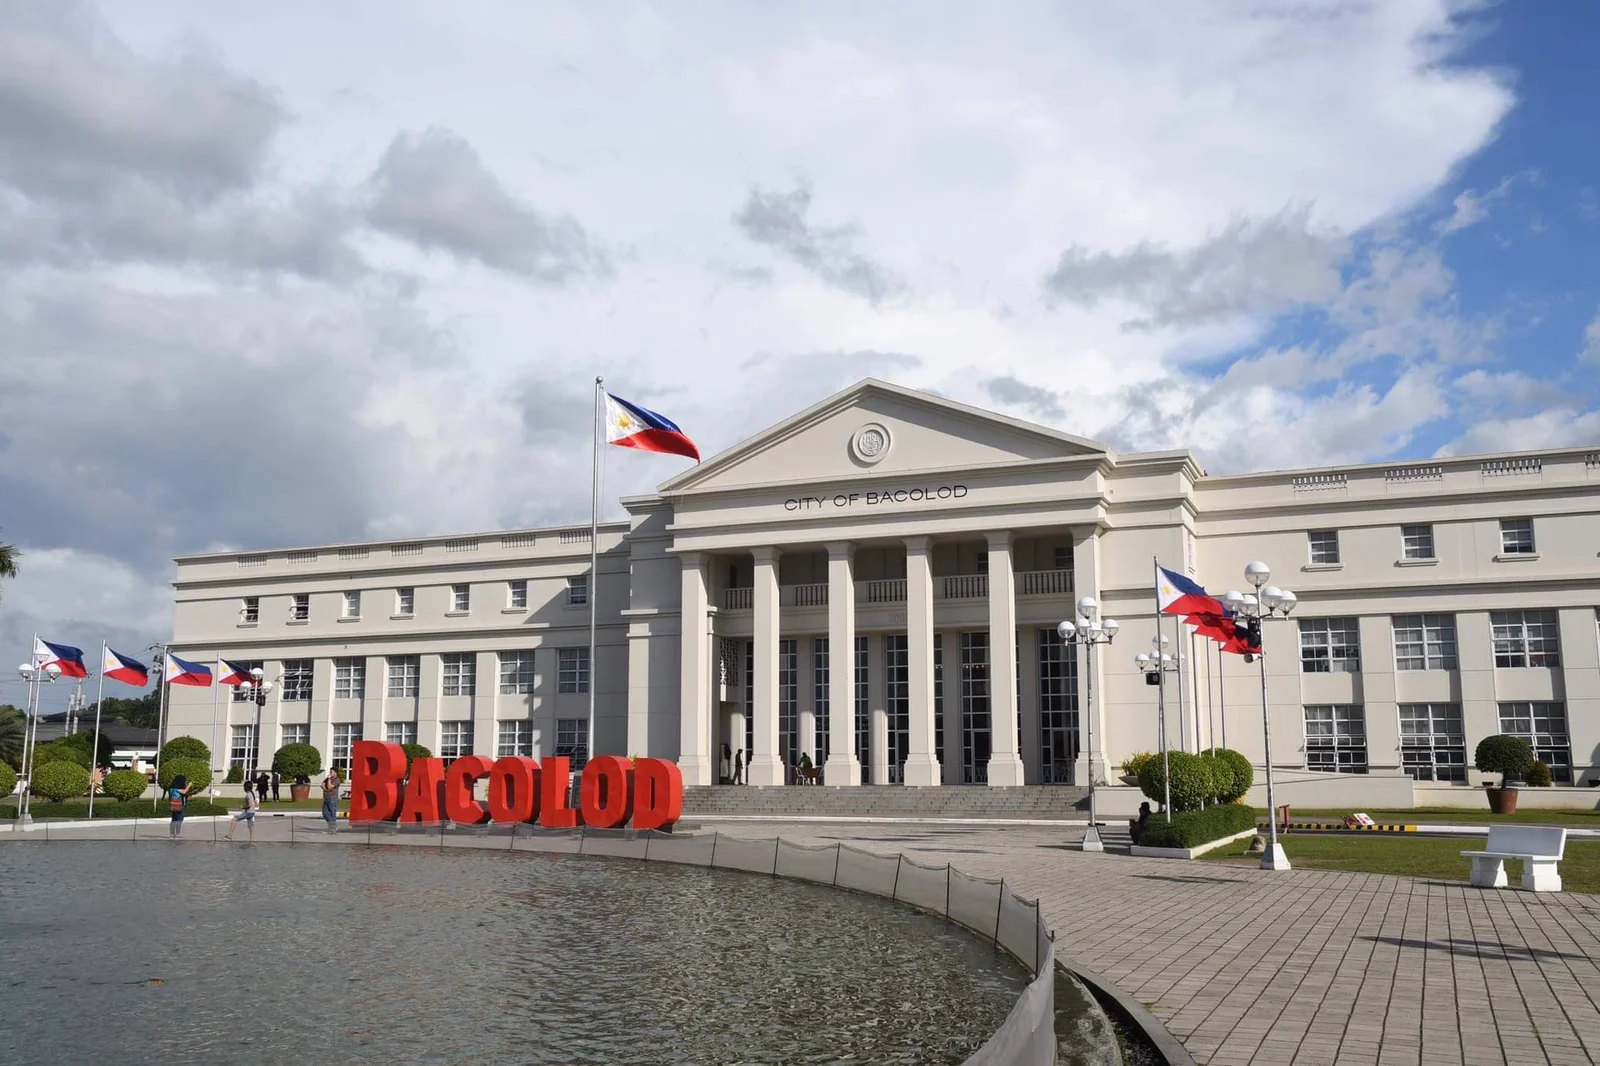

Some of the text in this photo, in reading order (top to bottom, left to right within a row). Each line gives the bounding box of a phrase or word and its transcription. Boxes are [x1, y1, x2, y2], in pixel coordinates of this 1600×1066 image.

[784, 485, 968, 511] CITY OF BACOLOD
[350, 740, 682, 829] BACOLOD
